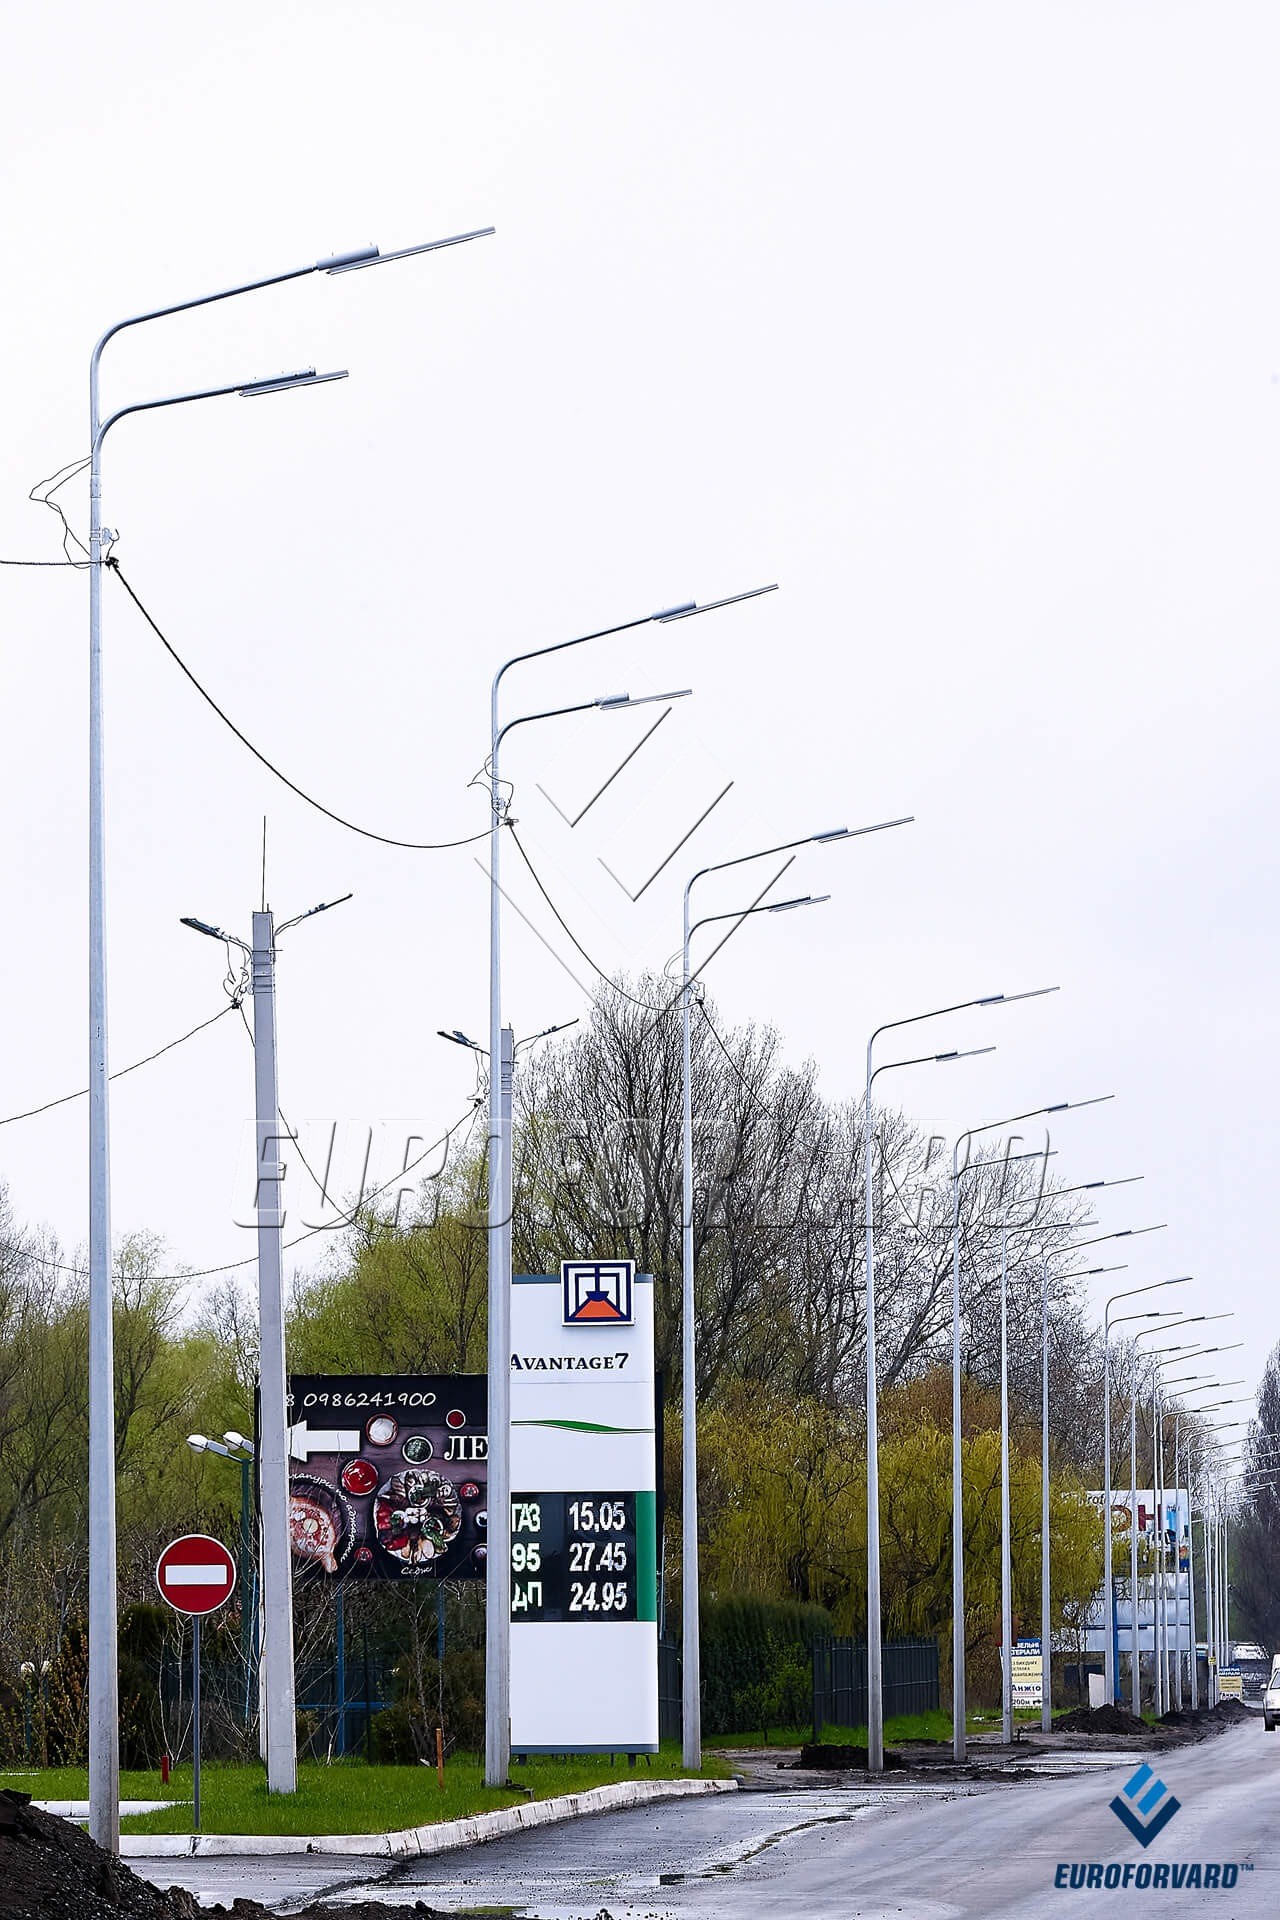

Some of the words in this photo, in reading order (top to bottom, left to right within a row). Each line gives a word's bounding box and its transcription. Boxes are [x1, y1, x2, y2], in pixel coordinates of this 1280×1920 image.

[303, 1392, 437, 1408] 0986241900
[511, 1503, 541, 1532] ГАЗ
[511, 1543, 541, 1572] 95
[569, 1542, 627, 1572] 27.45
[569, 1581, 628, 1612] 24.95
